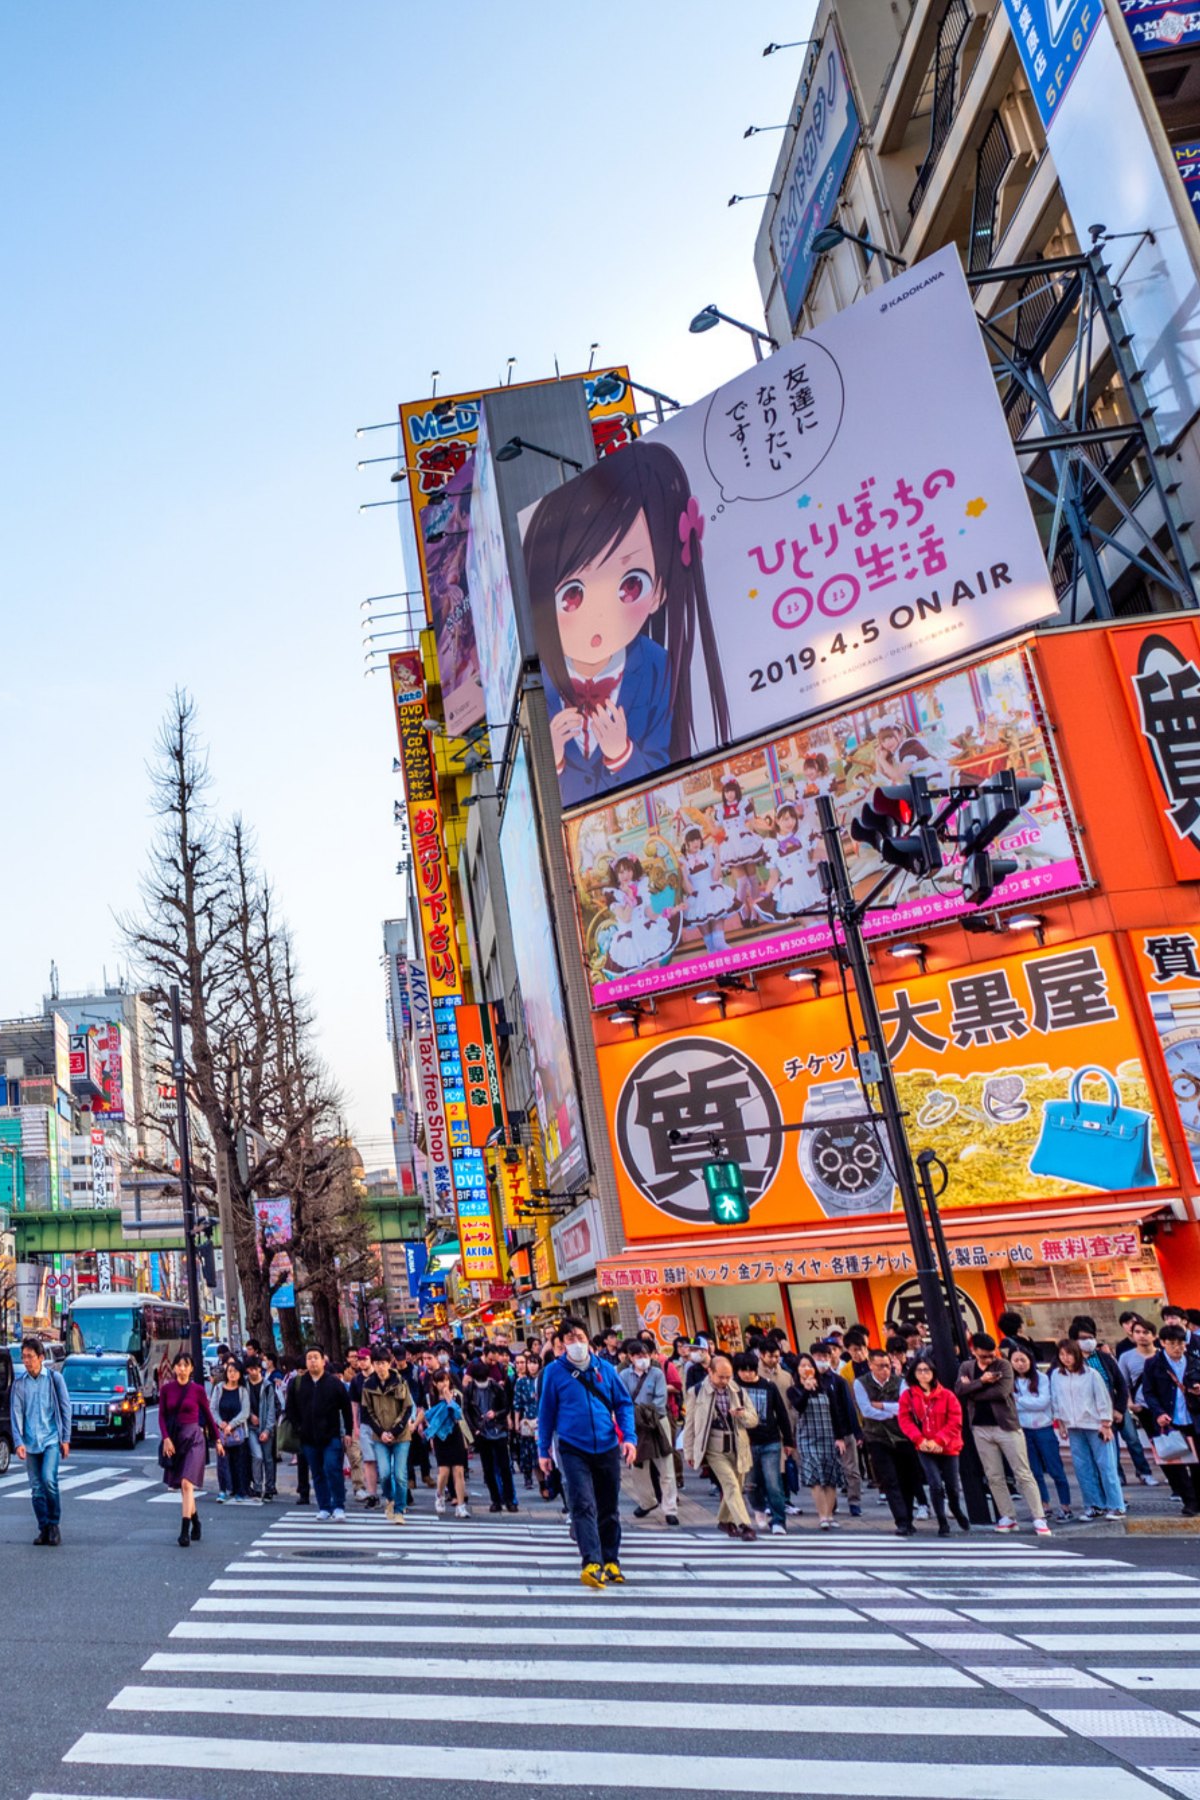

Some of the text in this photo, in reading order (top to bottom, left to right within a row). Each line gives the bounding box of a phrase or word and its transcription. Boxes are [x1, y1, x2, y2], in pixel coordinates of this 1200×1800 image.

[888, 270, 946, 309] KADOKAWA
[783, 363, 819, 436] 友達に
[755, 385, 793, 471] なりたい
[748, 468, 956, 581] ひとりぼっちの
[749, 561, 1013, 693] 2019.4.5 ON AIR
[400, 705, 423, 716] DVD
[402, 728, 426, 736] ゲーム
[407, 737, 423, 747] CD
[405, 759, 430, 769] アニメ
[408, 769, 430, 779] コミック
[409, 781, 431, 790] ホビー
[999, 827, 1041, 852] cafe
[445, 997, 462, 1007] 中古
[879, 946, 1119, 1064] 大黒屋
[440, 1050, 451, 1060] 4F
[408, 963, 446, 1164] AKKY Tax-free Shop
[464, 1043, 489, 1107] 吉野家
[443, 1077, 454, 1088] 3F
[632, 1054, 775, 1205] 質
[452, 1147, 482, 1158] 1F 中古
[456, 1174, 484, 1187] DVD
[471, 1190, 487, 1200] 中古
[465, 1247, 493, 1257] AKIBA
[406, 1248, 416, 1274] AKIBA
[600, 1267, 659, 1287] 高価買取
[1010, 1243, 1034, 1263] etc
[1040, 1232, 1139, 1263] 無料査定
